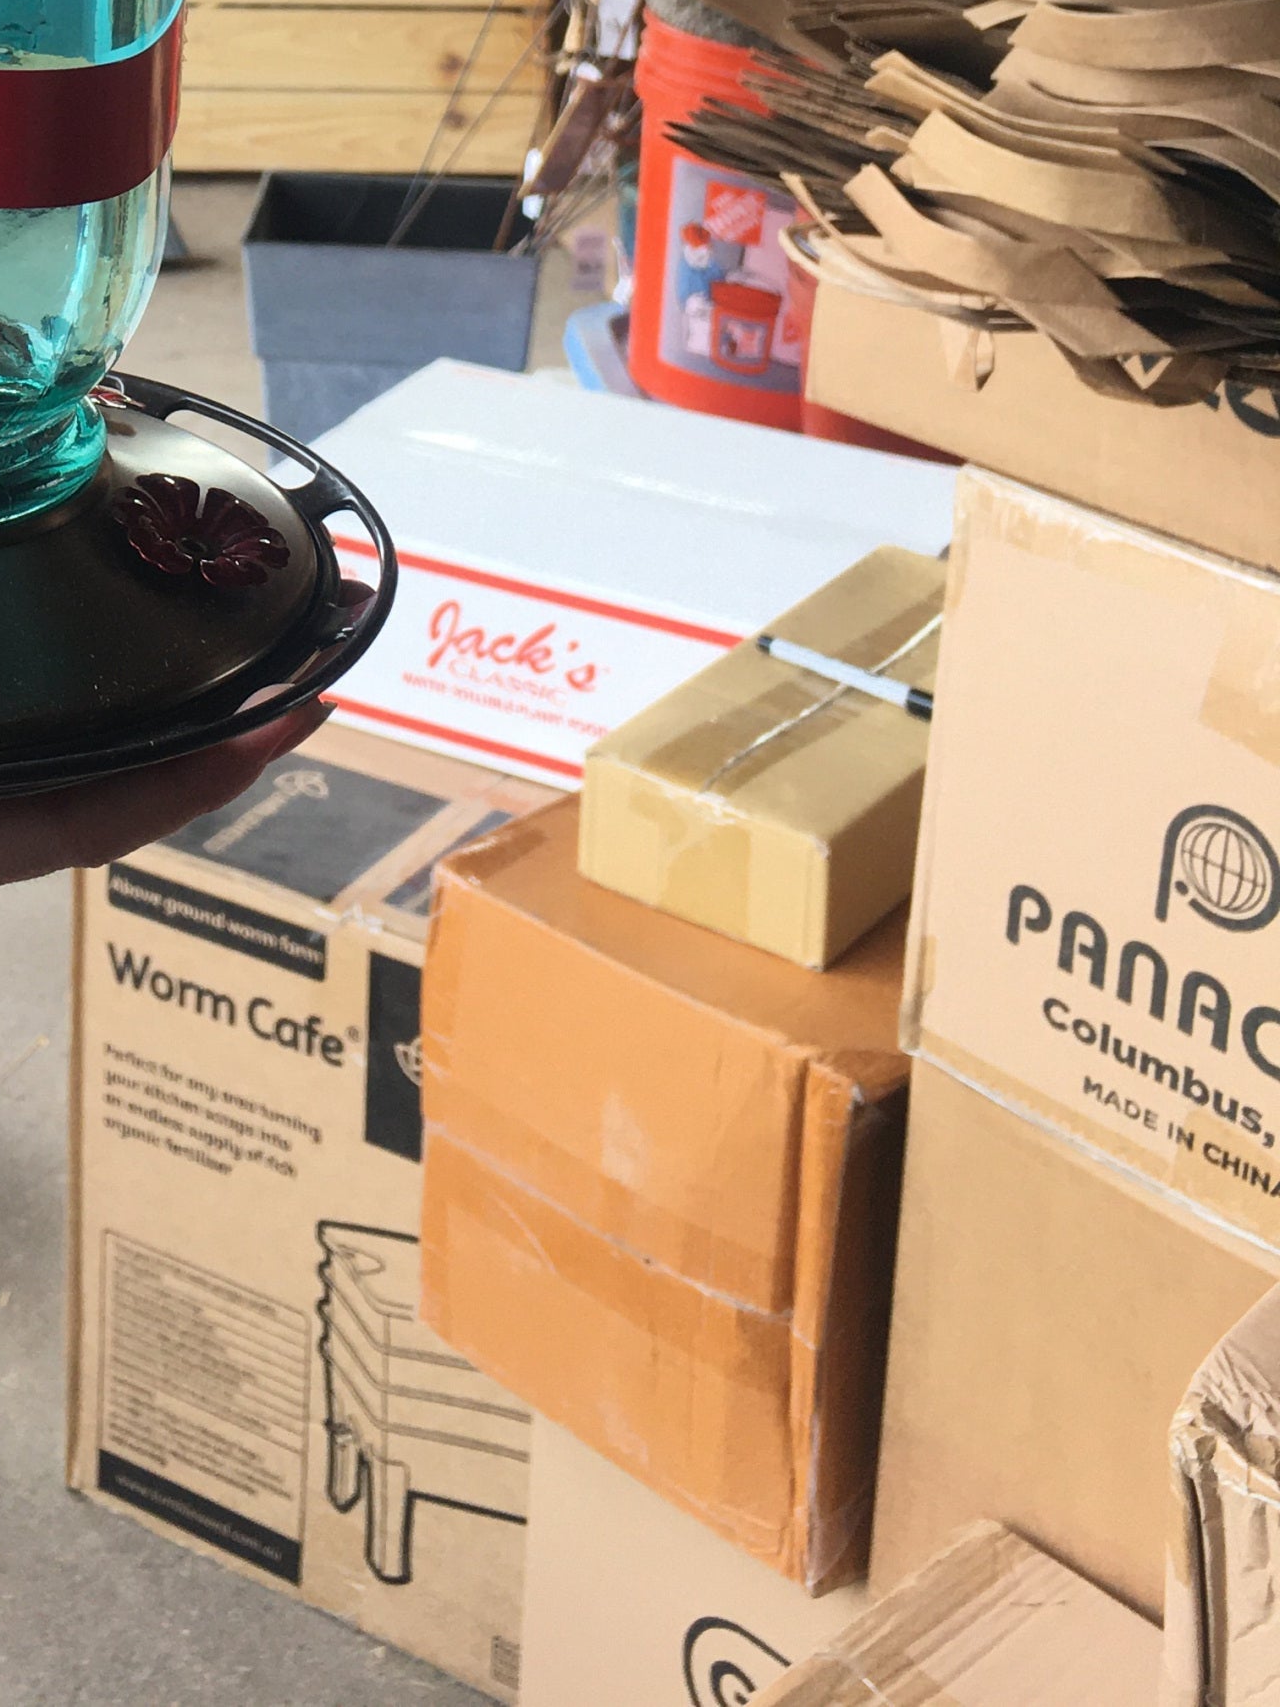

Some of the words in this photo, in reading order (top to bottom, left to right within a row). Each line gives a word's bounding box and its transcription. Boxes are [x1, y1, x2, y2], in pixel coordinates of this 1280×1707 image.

[429, 599, 598, 692] Jack's
[447, 657, 569, 708] CLASSIC
[106, 942, 236, 1027] Worm
[1043, 998, 1274, 1148] Columbus,
[1083, 1076, 1158, 1130] MADE
[1167, 1121, 1194, 1152] IN
